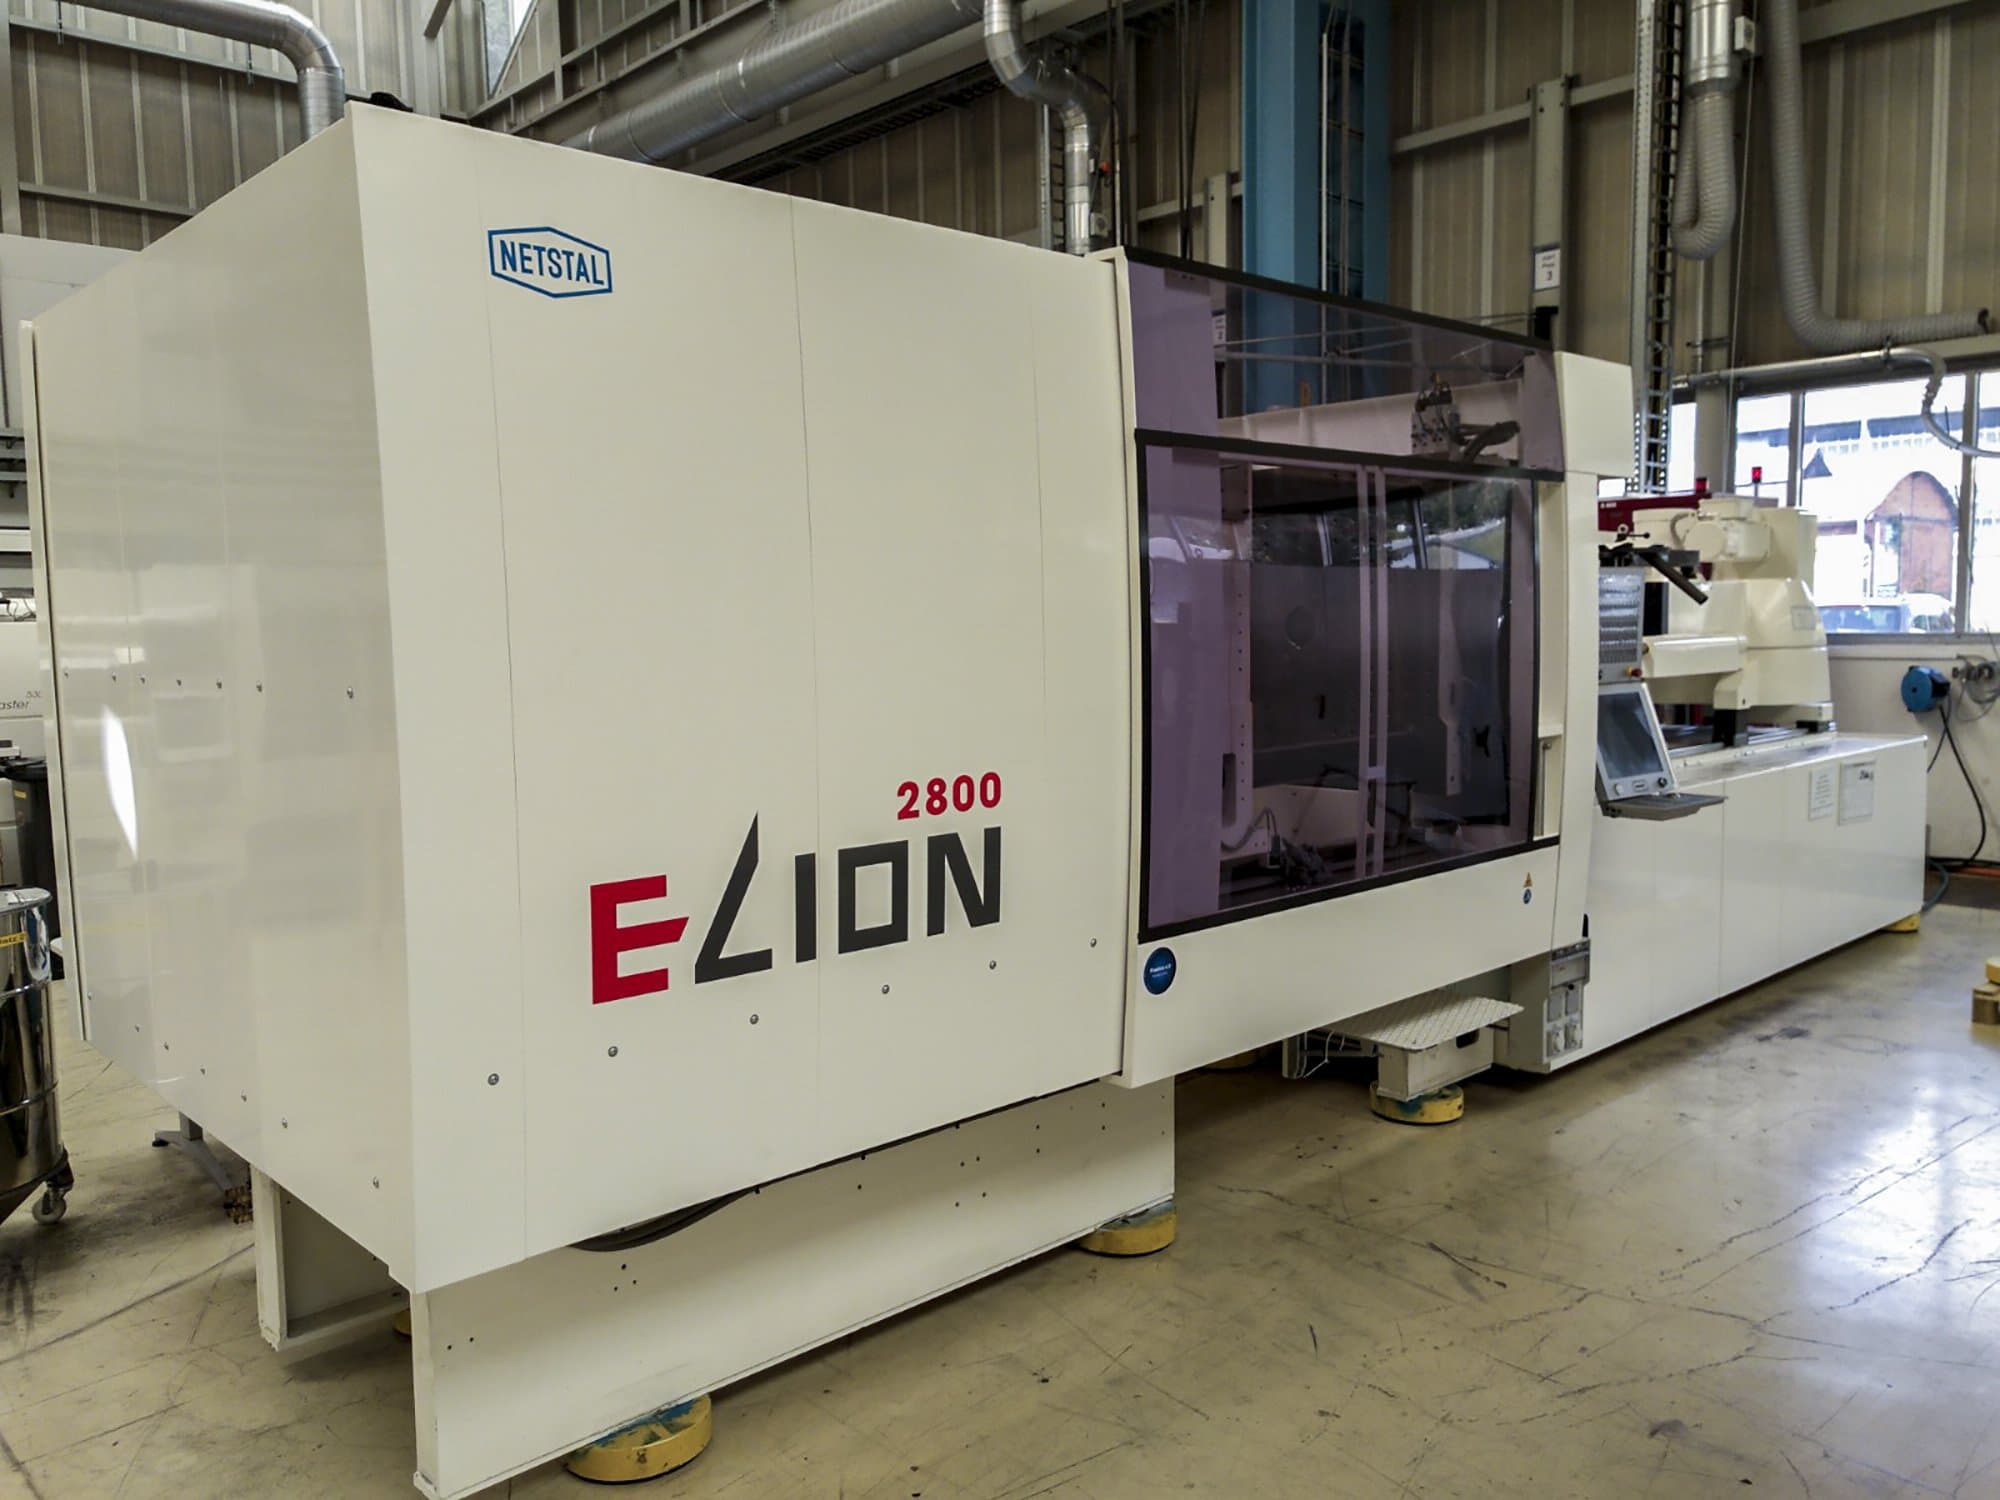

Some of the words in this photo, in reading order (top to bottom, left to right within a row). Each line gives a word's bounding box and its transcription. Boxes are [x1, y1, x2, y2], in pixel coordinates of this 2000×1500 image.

[500, 239, 605, 285] NETSTAL
[897, 772, 1001, 820] 2800
[590, 811, 1001, 1004] ELION
